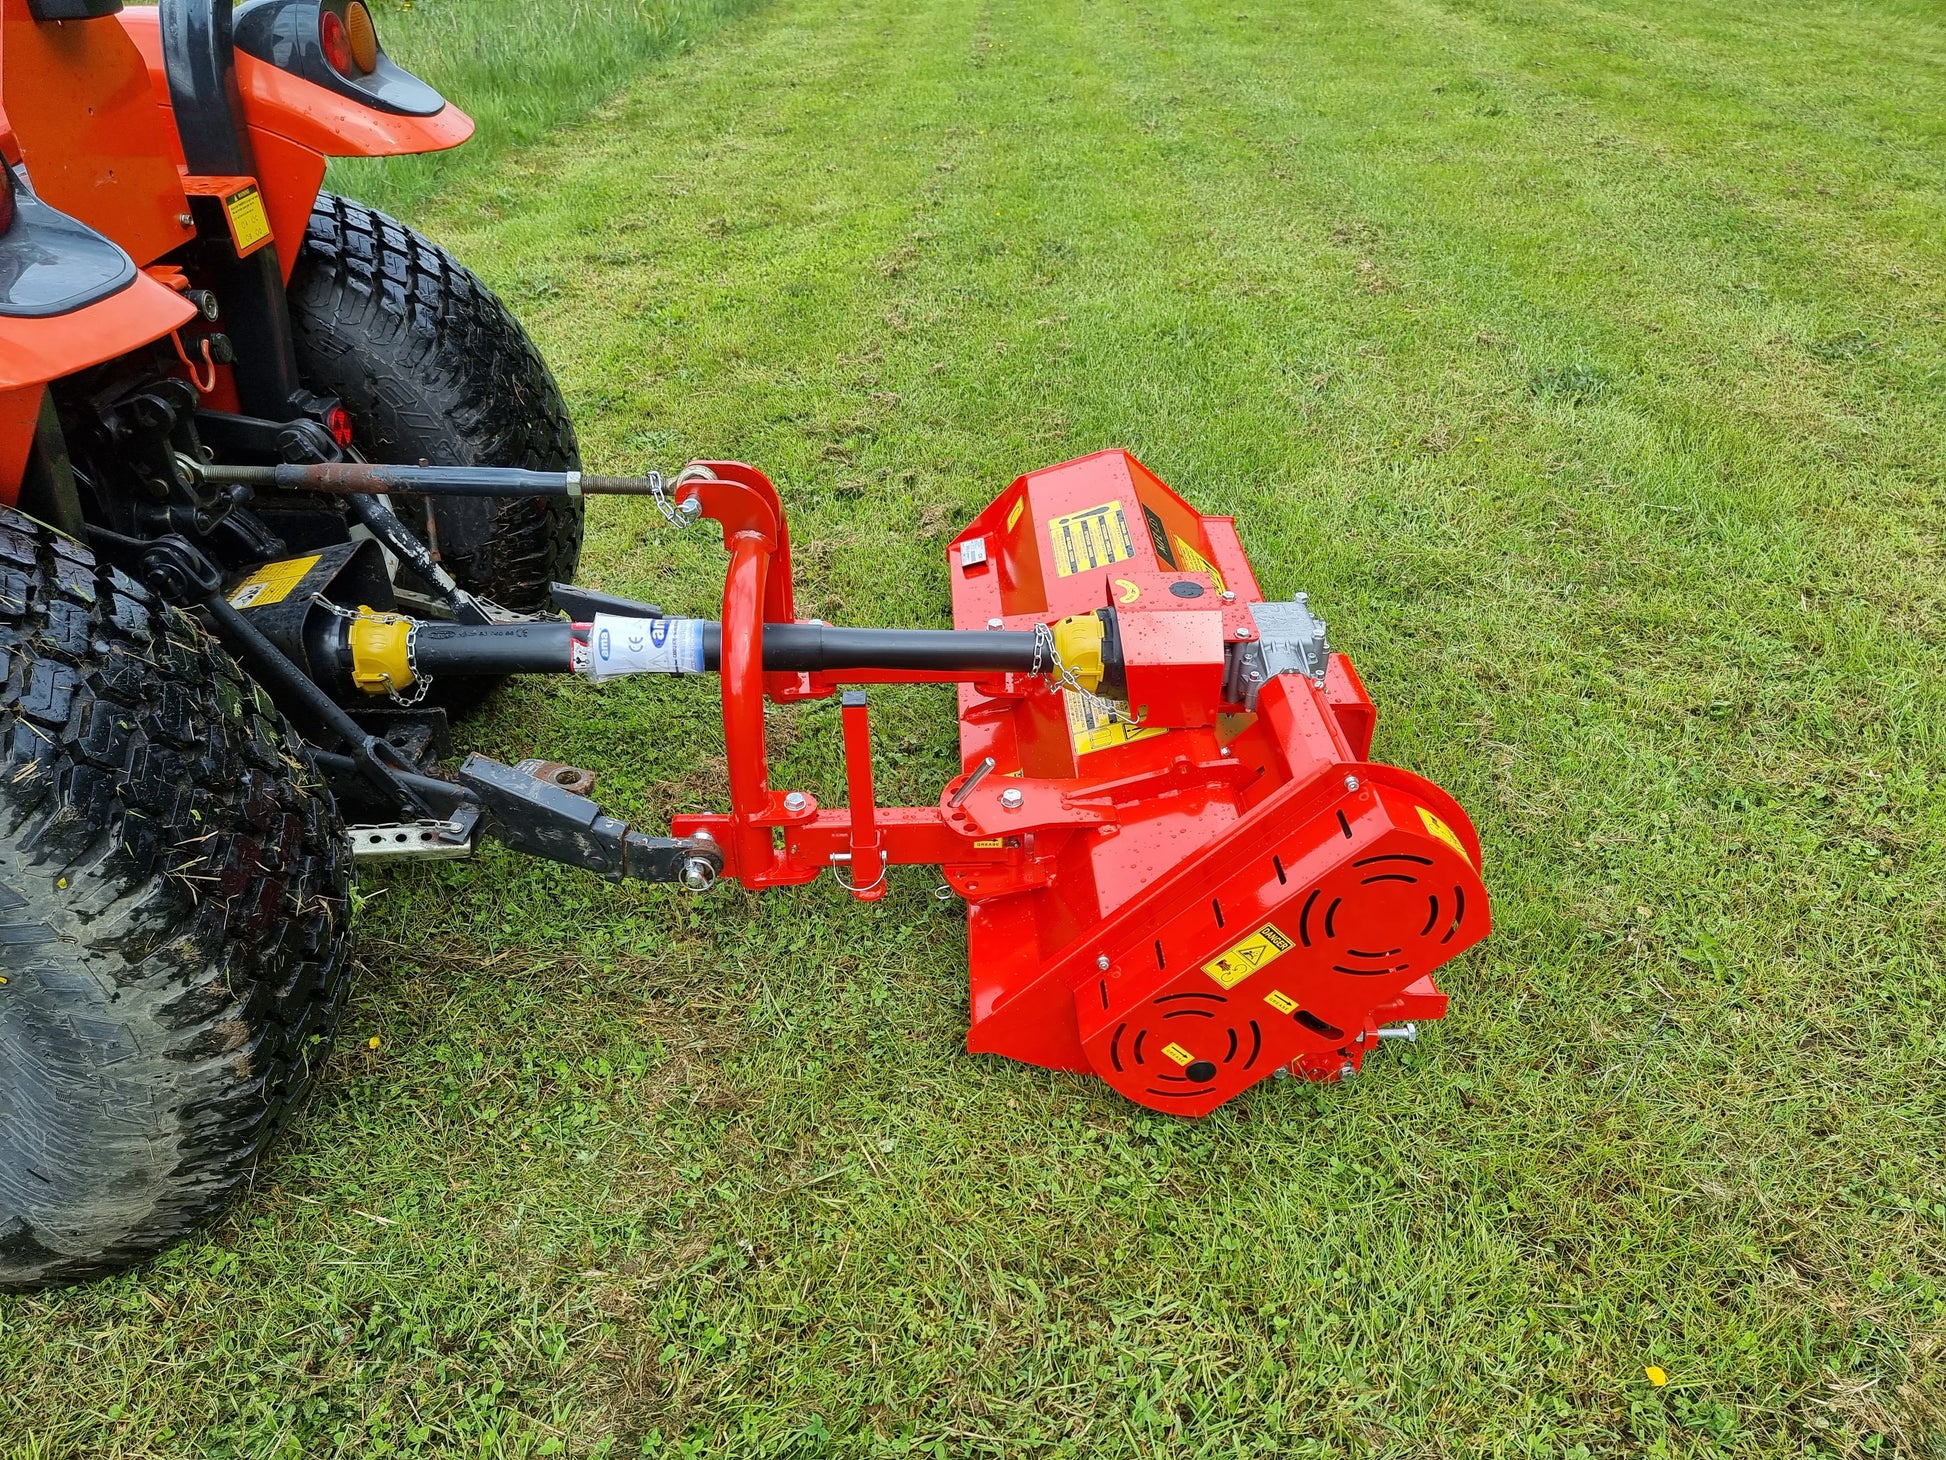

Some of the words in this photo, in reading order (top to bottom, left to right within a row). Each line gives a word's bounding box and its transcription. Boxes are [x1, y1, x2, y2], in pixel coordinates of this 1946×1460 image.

[600, 631, 609, 658] ama
[1261, 927, 1289, 951] DANGER
[1268, 997, 1289, 1011] GREASE
